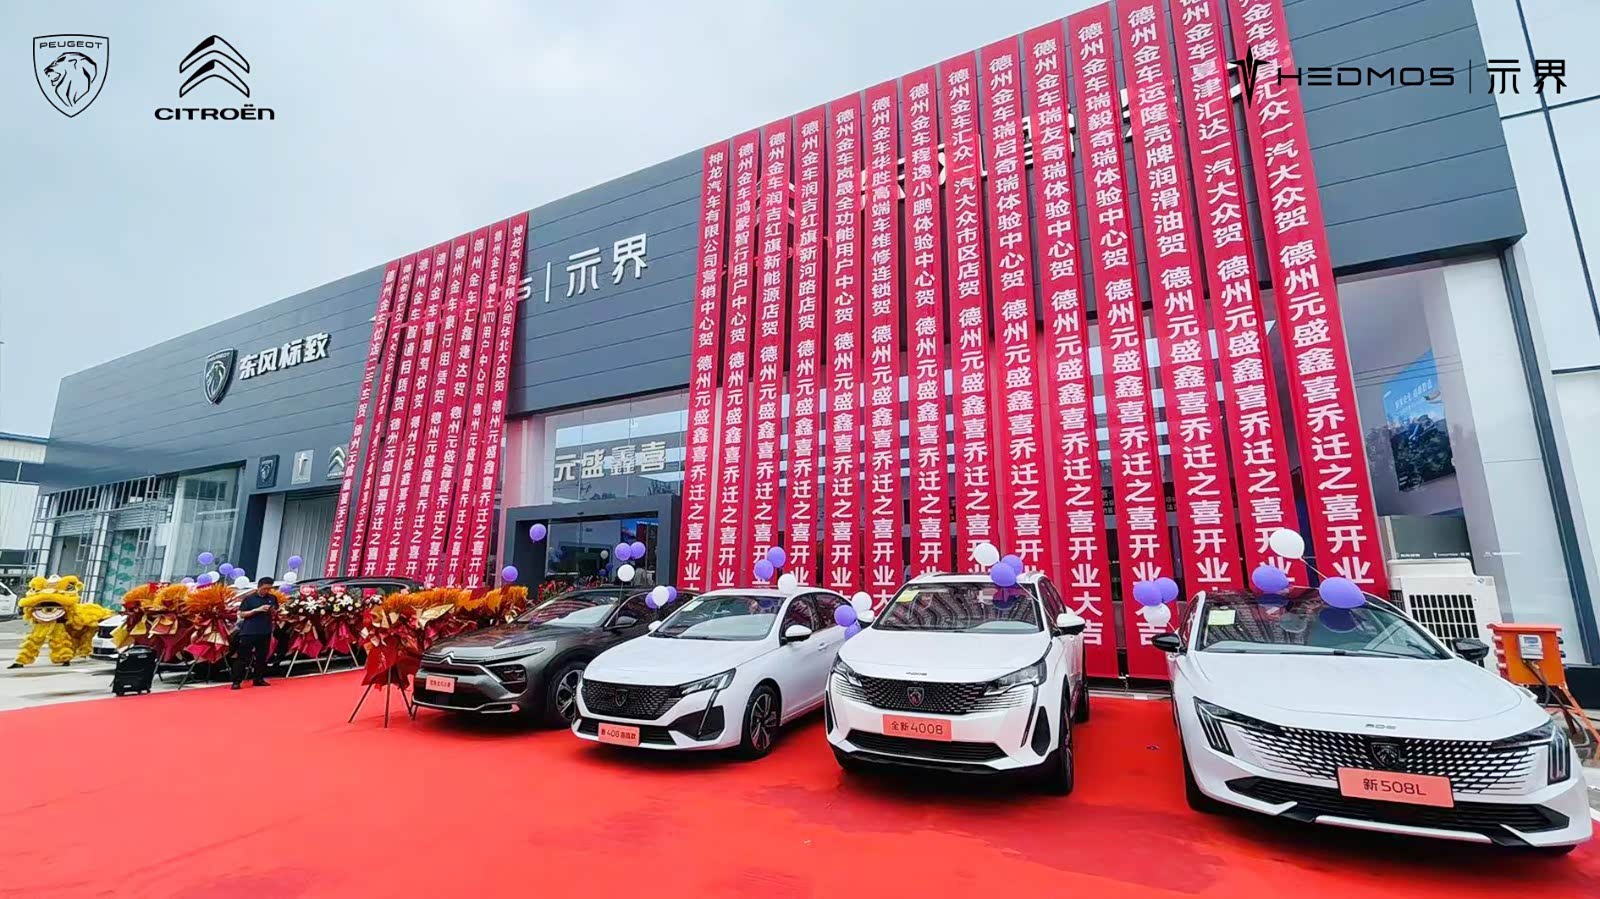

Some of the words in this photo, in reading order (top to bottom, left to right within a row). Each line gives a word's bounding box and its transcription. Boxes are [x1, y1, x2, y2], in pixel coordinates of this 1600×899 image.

[566, 233, 648, 298] 示界
[698, 152, 723, 347] 神龙汽车有限公司营销中心贺
[729, 143, 754, 343] 德州金车鸿蒙智行用户中心贺
[761, 132, 785, 337] 德州金车润吉红旗新能源店贺
[798, 120, 819, 332] 德州金车润吉红旗新河路店贺
[834, 109, 854, 324] 德州金车岚晟全功能用户中心贺
[871, 96, 891, 317] 德州金车华胜高端车维修连锁贺
[909, 82, 935, 307] 德州金车程逸小鹏体验中心贺
[948, 68, 980, 298] 德州金车汇众一汽大众市区店贺
[988, 54, 1025, 290] 德州金车瑞启奇瑞体验中心贺
[1033, 38, 1075, 280] 德州金车瑞友奇瑞体验中心贺
[239, 332, 330, 380] 东风标致
[1078, 22, 1128, 270] 德州金车瑞毅奇瑞体验中心贺
[1104, 278, 1166, 646] 德州元盛鑫喜乔迁之喜开业吉
[1127, 5, 1186, 258] 德州金车运隆壳牌润滑油贺
[1161, 266, 1231, 590] 德州元盛鑫喜乔迁之喜开业
[553, 441, 666, 482] 元盛鑫喜
[717, 351, 745, 586] 德州元盛鑫喜乔迁之喜开业
[891, 721, 944, 735] 全新4008
[1362, 778, 1427, 796] 新508L
